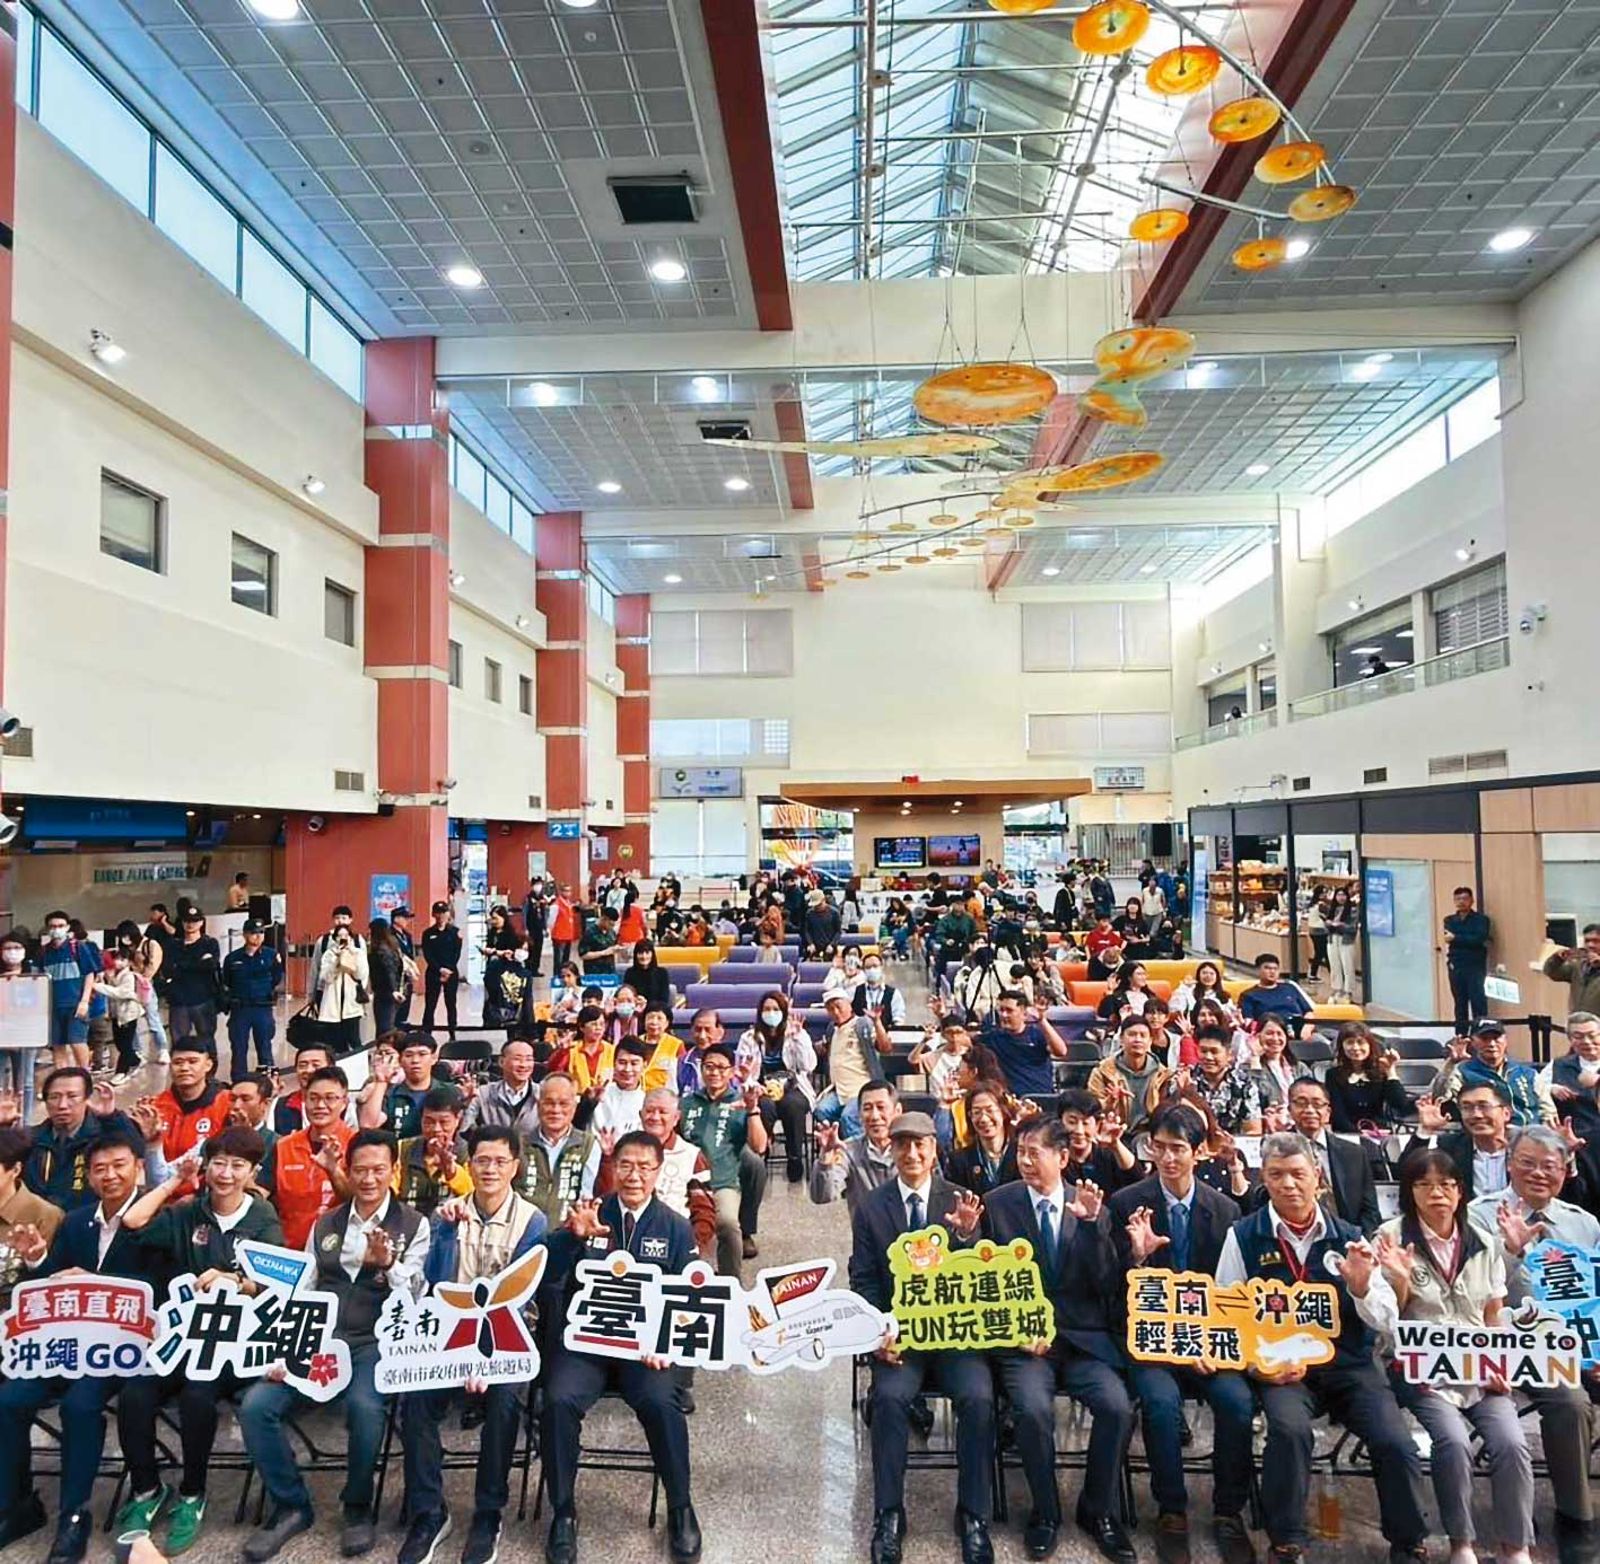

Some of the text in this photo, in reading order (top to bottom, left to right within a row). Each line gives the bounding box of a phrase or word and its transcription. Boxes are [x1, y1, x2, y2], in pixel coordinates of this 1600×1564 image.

[551, 823, 563, 837] 2
[253, 1255, 300, 1277] OKINAWA
[1534, 1250, 1600, 1301] 臺
[21, 1289, 142, 1324] 臺南直飛
[899, 1267, 1036, 1307] 虎航連線
[1135, 1275, 1334, 1330] 臺南 沖繩
[156, 1284, 330, 1378] 沖繩
[383, 1299, 440, 1342] 臺南
[573, 1262, 731, 1361] 臺南
[895, 1304, 1049, 1344] FUN玩雙城
[9, 1338, 78, 1371] 沖繩
[388, 1343, 438, 1357] TAINAN
[1135, 1318, 1241, 1361] 輕鬆飛
[1398, 1326, 1577, 1351] Welcome to
[1400, 1352, 1575, 1384] TAINAN
